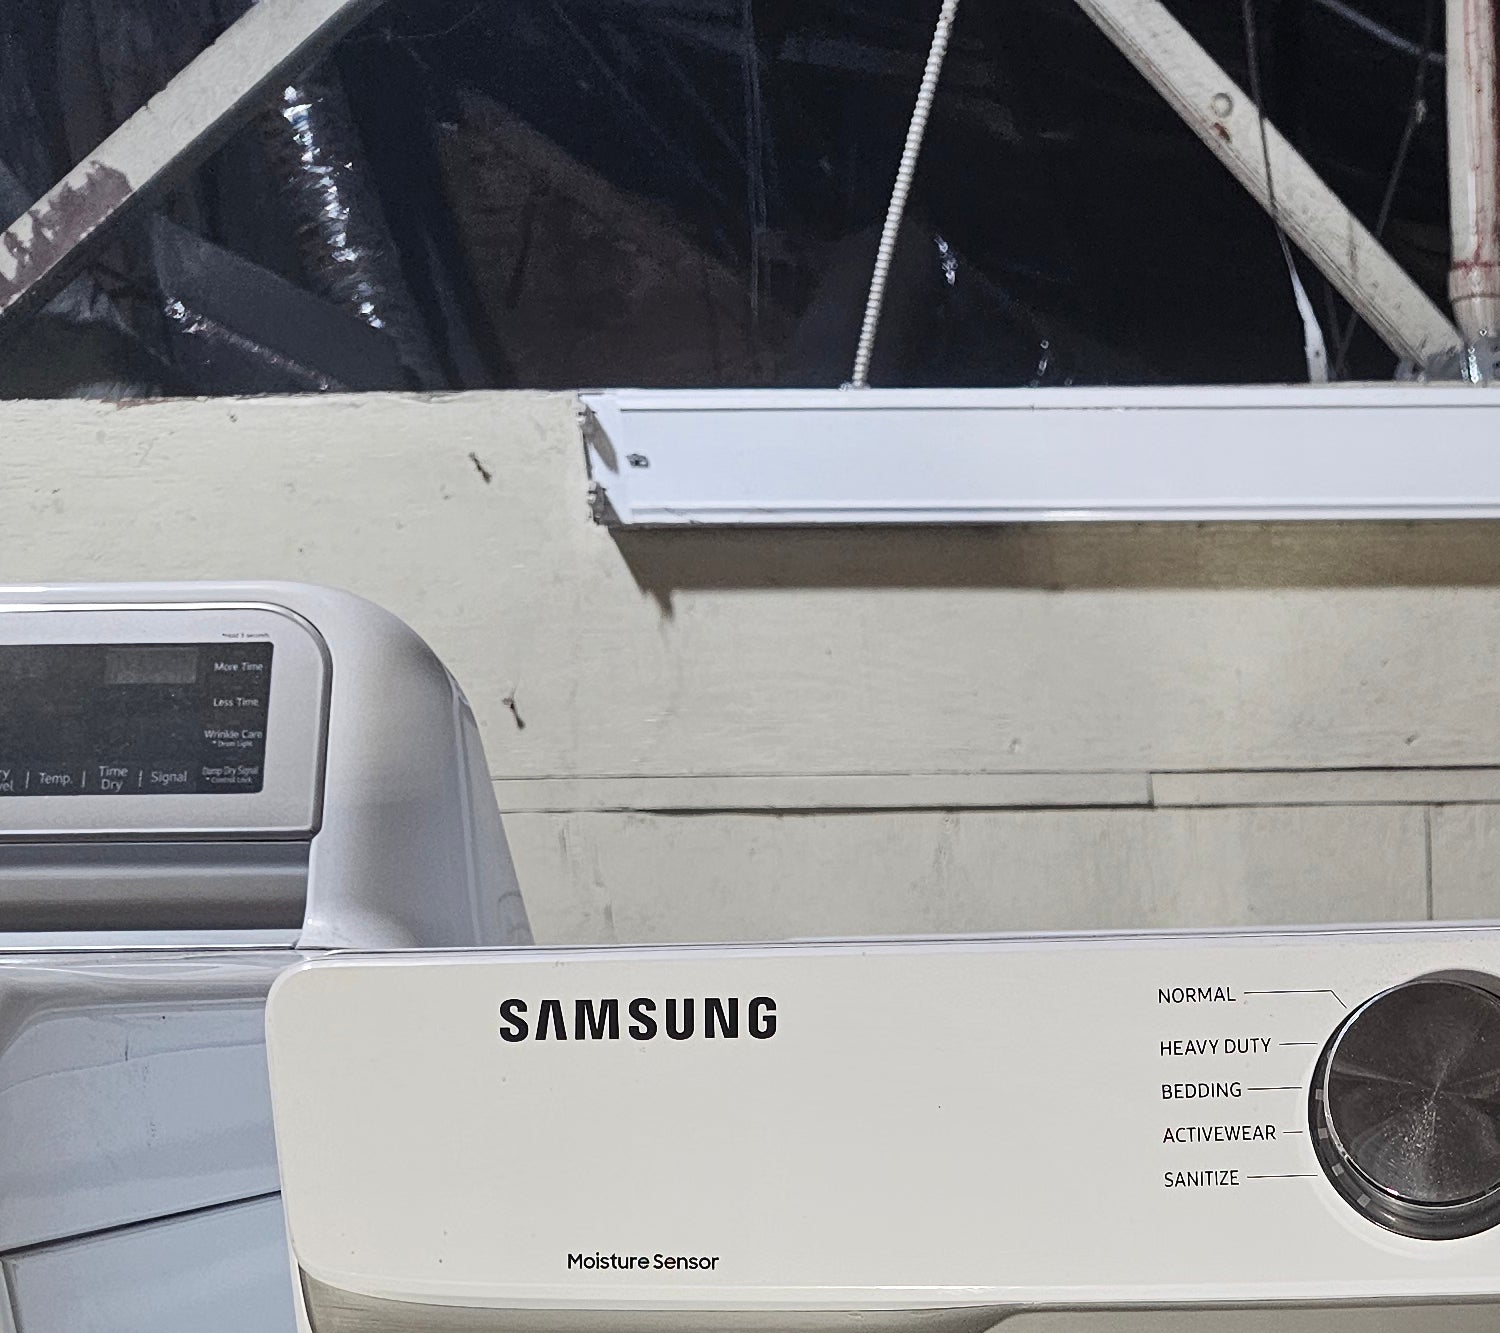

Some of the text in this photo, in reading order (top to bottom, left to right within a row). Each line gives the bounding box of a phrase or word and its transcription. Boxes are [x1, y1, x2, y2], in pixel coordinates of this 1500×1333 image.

[213, 662, 264, 672] More Time
[213, 698, 234, 707] Less
[39, 772, 73, 786] Temp.
[99, 765, 129, 777] Time
[151, 770, 188, 785] Signal
[101, 779, 123, 793] Dry
[1157, 986, 1237, 1004] NORMAL
[499, 996, 777, 1043] SAMSUNG
[1160, 1037, 1272, 1056] HEAVY DUTY
[1161, 1082, 1242, 1100] BEDDING
[1162, 1124, 1277, 1144] ACTIVEWEAR
[1164, 1170, 1240, 1188] SANITIZE
[567, 1251, 720, 1270] Moisture Sensor
